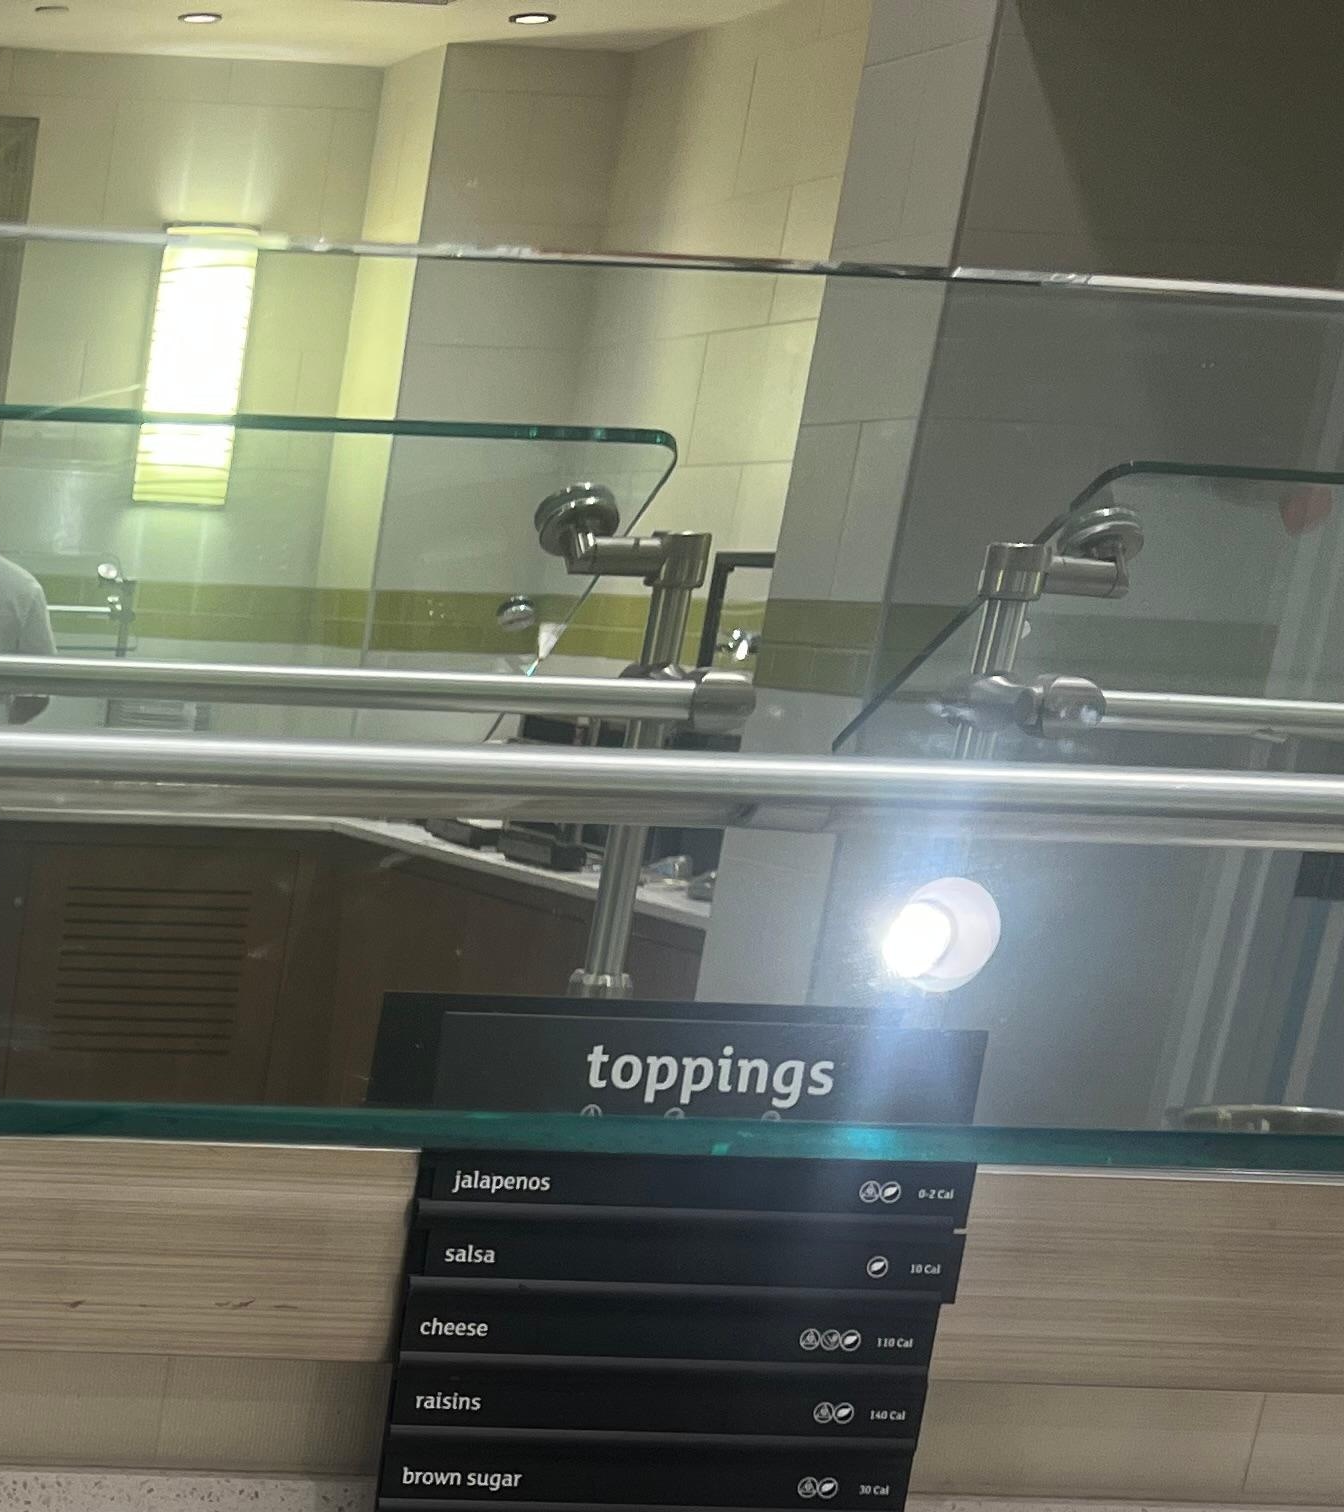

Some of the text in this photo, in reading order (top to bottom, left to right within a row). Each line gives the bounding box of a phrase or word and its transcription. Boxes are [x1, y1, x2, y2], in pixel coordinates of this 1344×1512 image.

[587, 1044, 836, 1109] toppings
[451, 1170, 551, 1194] jalapenos
[937, 1188, 955, 1200] Cal
[444, 1244, 495, 1264] salsa
[923, 1263, 941, 1275] Cal
[419, 1317, 489, 1337] cheese
[877, 1337, 914, 1348] 110 Cal
[415, 1391, 482, 1411] raisins
[889, 1410, 906, 1421] Cal
[402, 1466, 523, 1492] brown sugar
[872, 1485, 890, 1496] Cal
